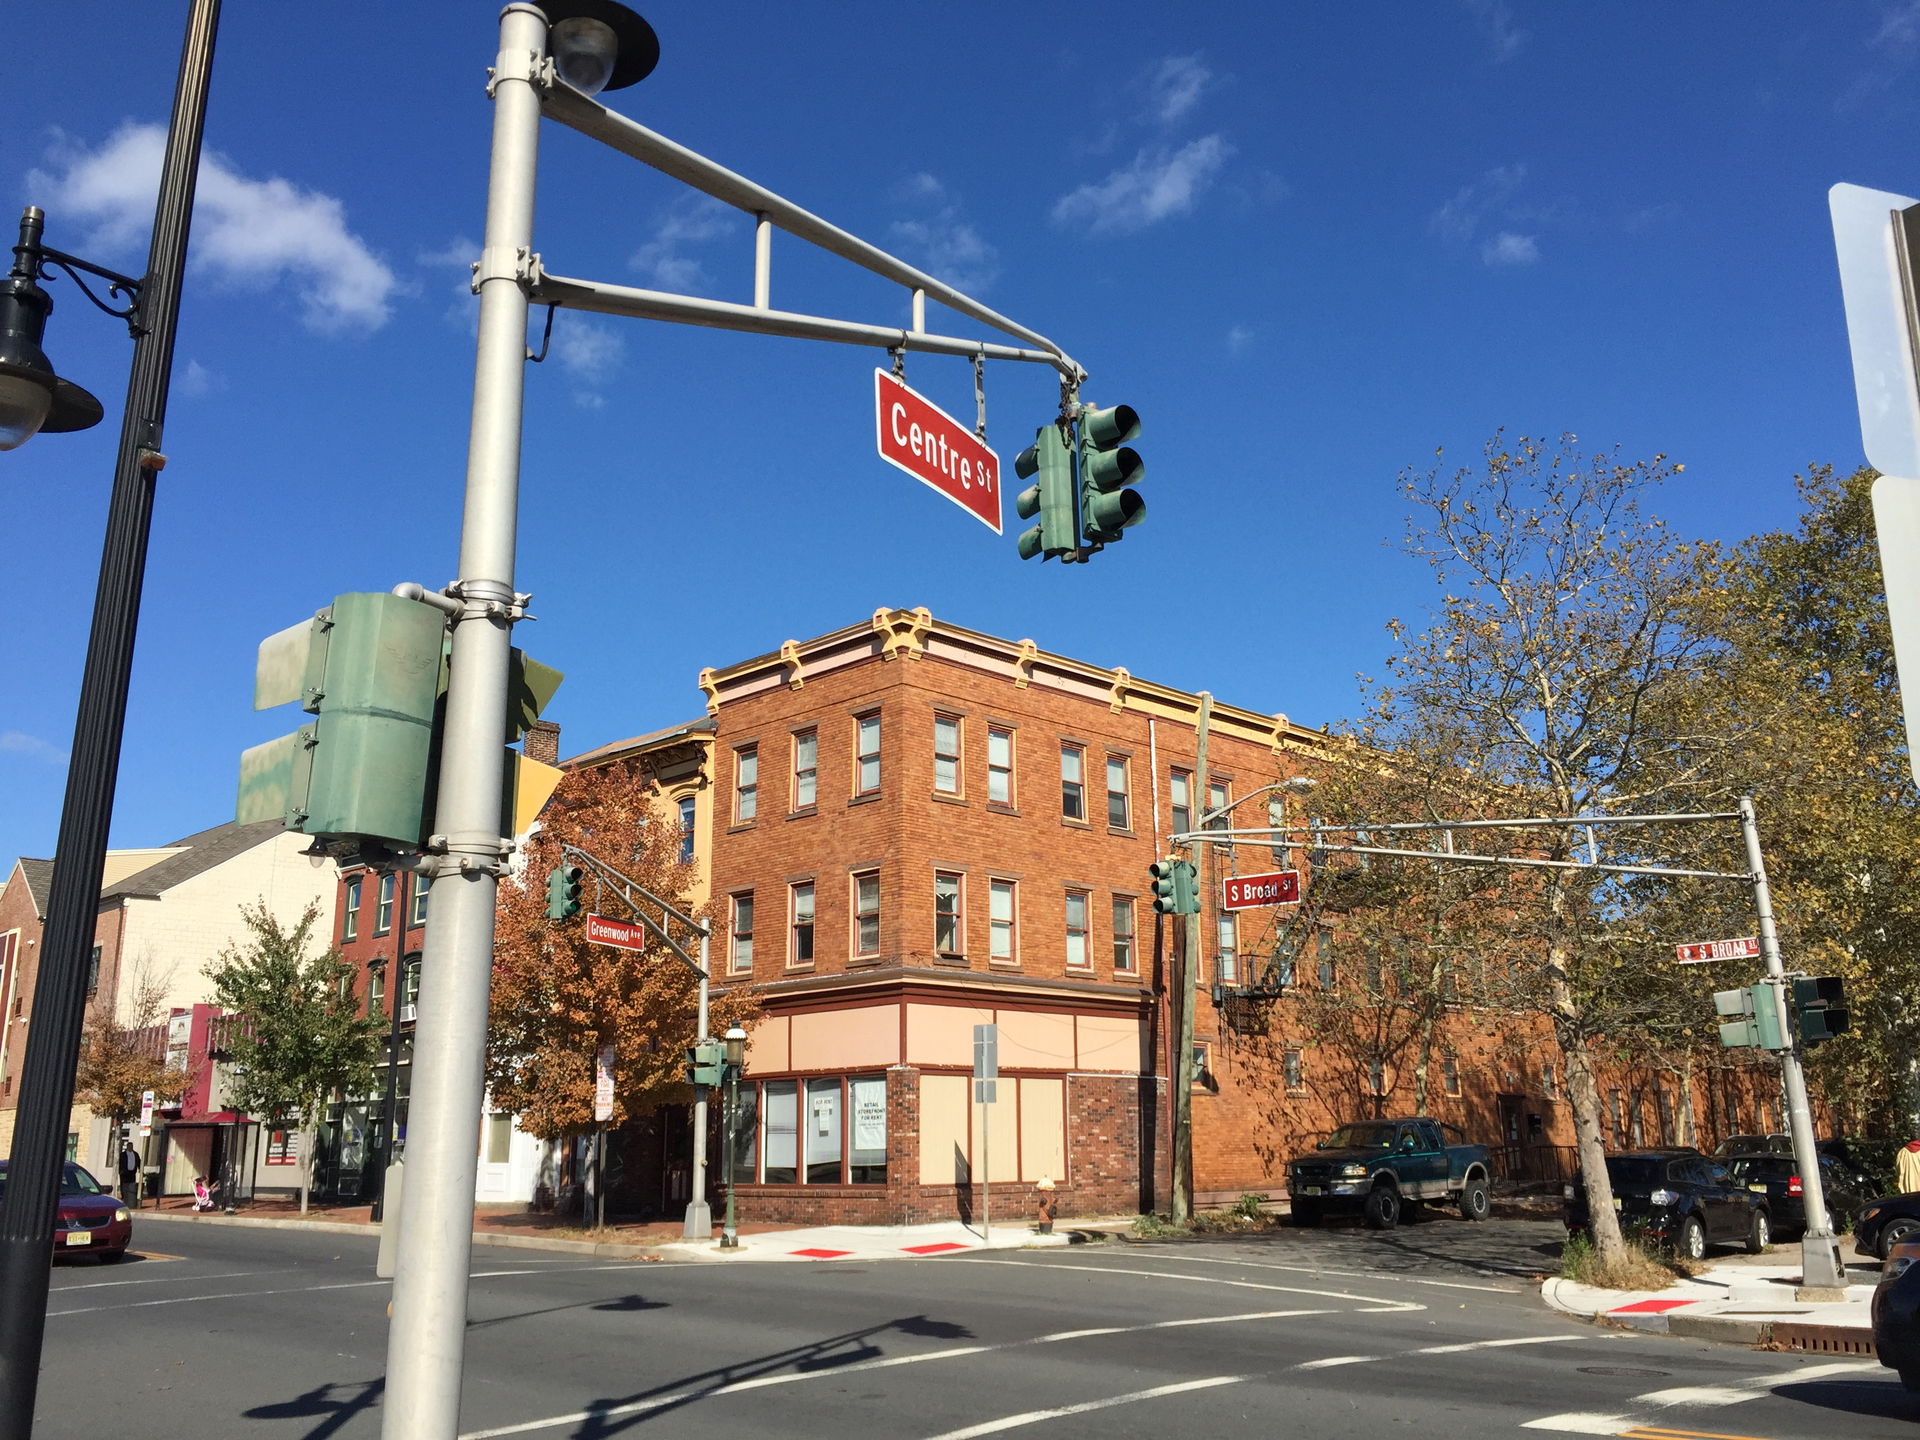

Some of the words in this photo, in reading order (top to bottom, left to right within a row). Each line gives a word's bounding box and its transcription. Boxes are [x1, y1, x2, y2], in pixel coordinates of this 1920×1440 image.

[892, 402, 971, 490] Centre
[977, 460, 992, 493] St
[1231, 885, 1239, 901] S
[1244, 882, 1278, 900] Broad
[1283, 879, 1292, 890] St
[591, 921, 629, 942] Greenwood
[630, 929, 641, 940] Ave
[1711, 941, 1746, 958] BROAD
